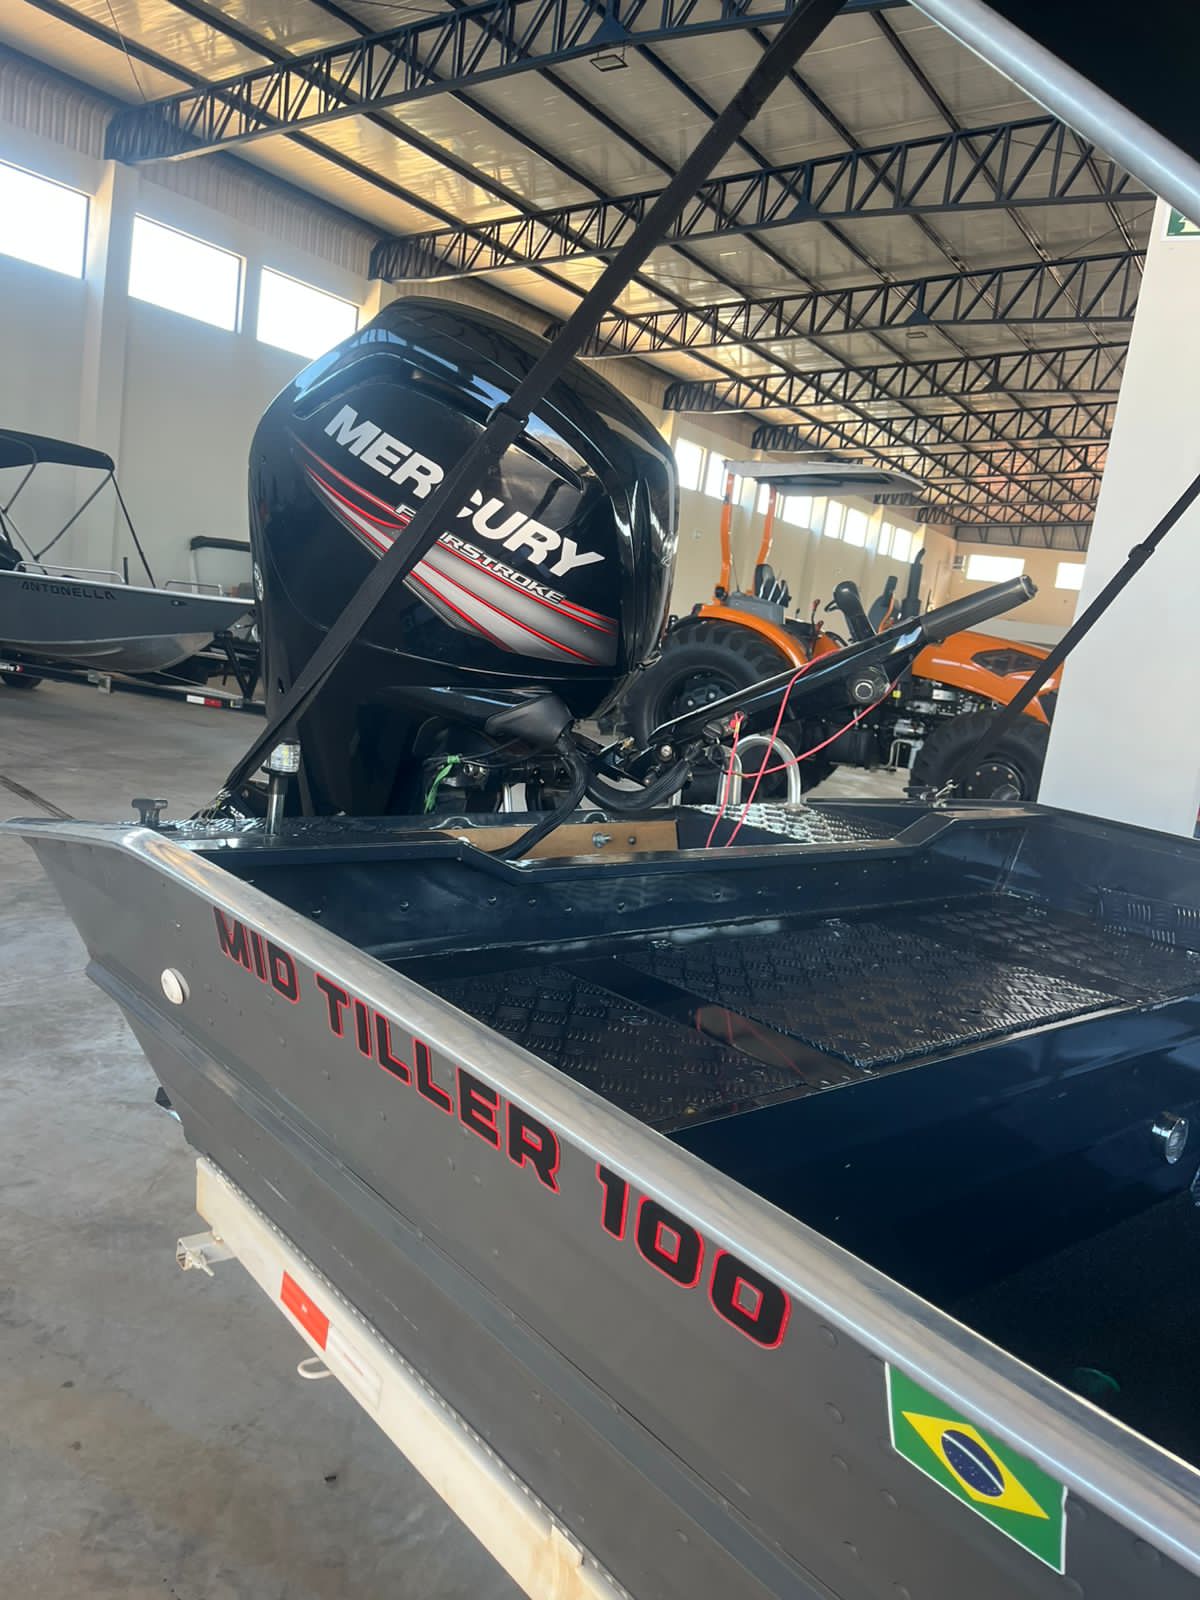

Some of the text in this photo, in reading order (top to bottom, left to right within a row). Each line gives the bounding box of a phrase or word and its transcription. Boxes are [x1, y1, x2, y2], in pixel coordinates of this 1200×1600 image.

[324, 404, 605, 577] MERURY
[396, 504, 566, 603] FRSTROKE
[21, 581, 117, 600] ANTONELLA
[212, 905, 792, 1350] MID TILLER 100
